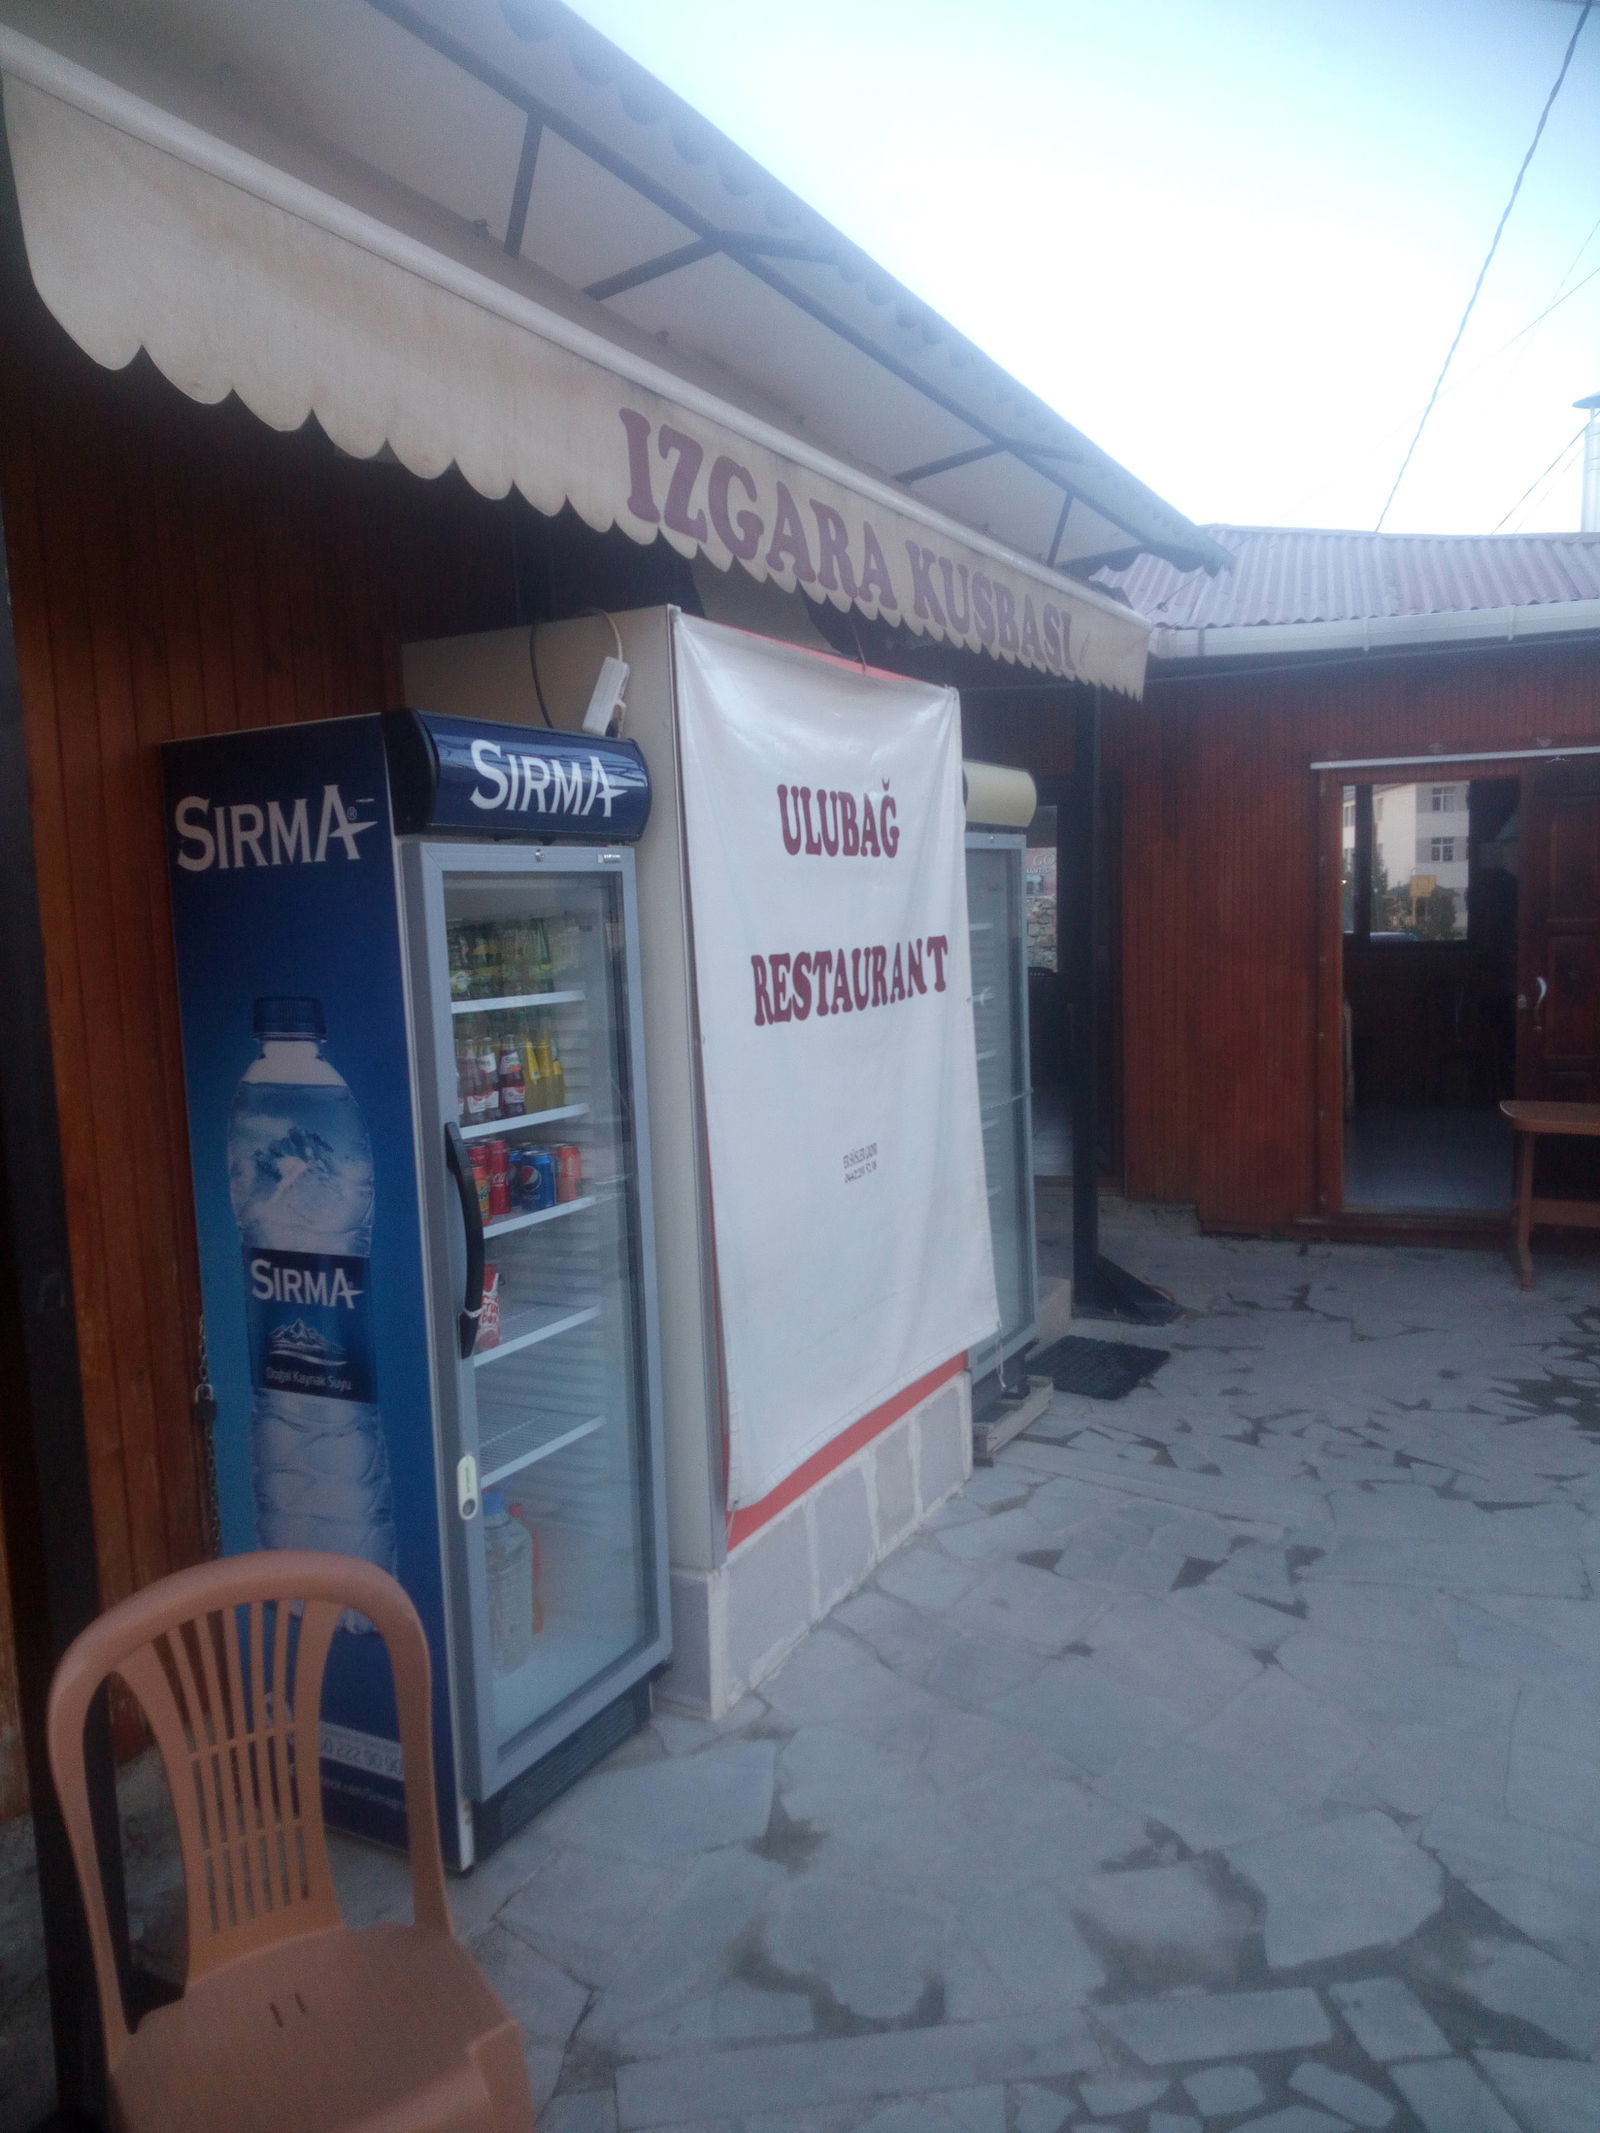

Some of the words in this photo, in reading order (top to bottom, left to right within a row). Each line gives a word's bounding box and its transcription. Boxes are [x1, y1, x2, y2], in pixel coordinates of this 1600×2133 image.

[619, 406, 898, 612] IZGARA
[468, 738, 629, 818] SIRMA
[776, 777, 900, 859] ULUBAĞ
[174, 784, 379, 872] SIRMA
[750, 934, 948, 1027] RESTAURANT
[250, 1258, 365, 1310] SIRMA
